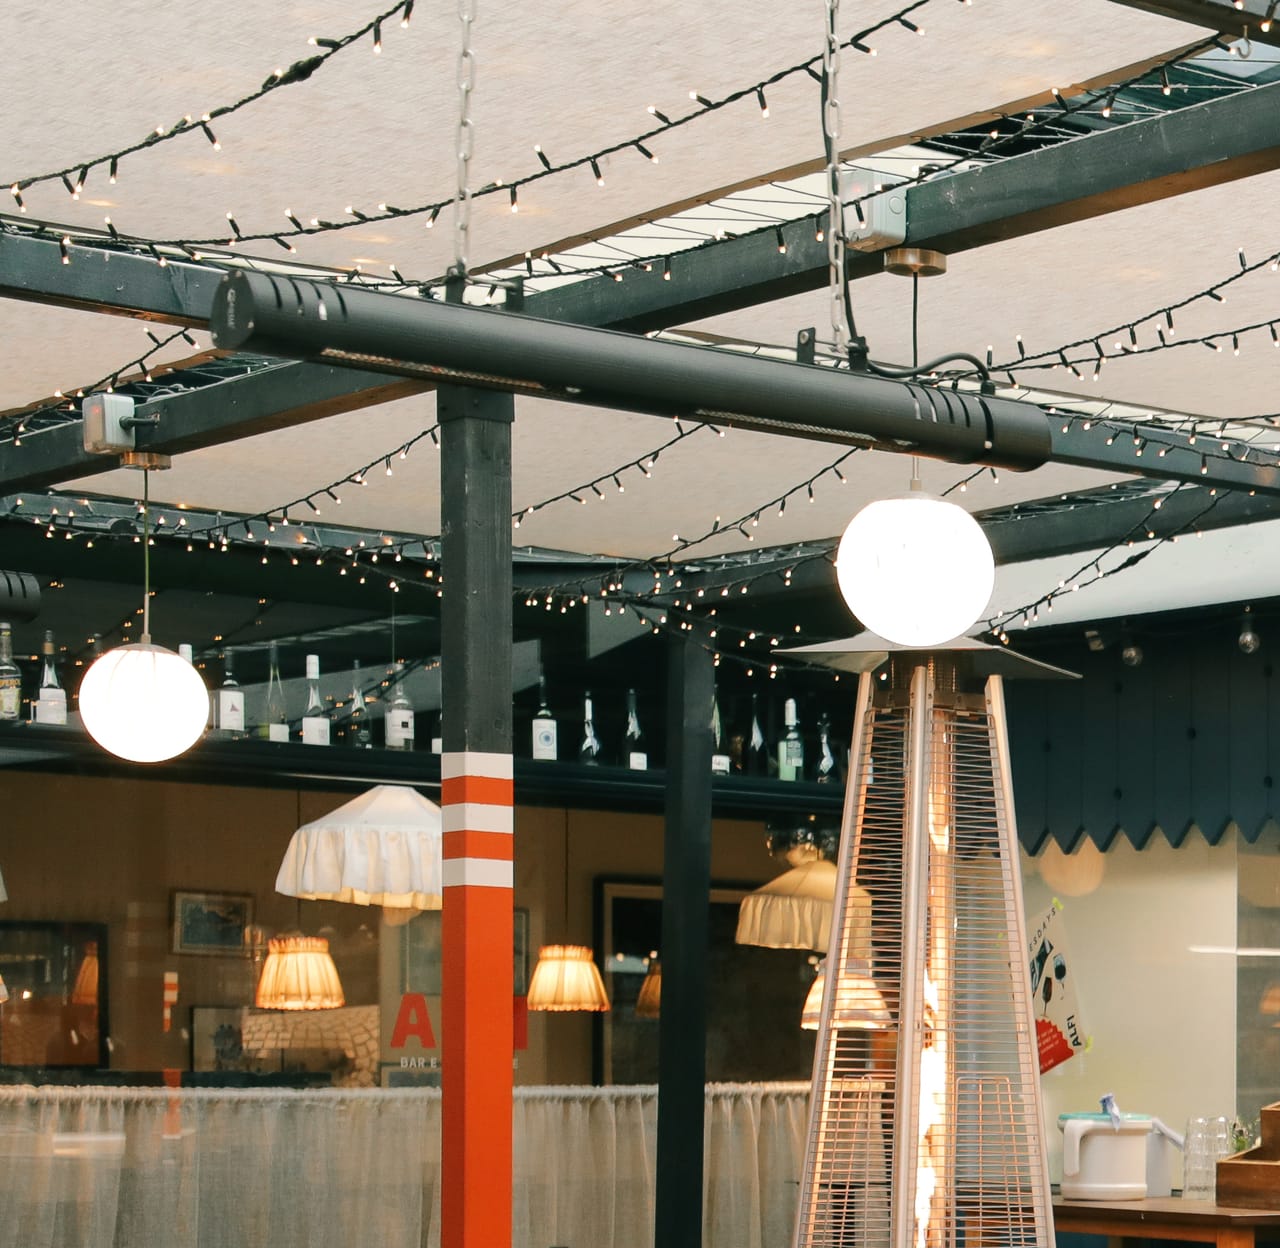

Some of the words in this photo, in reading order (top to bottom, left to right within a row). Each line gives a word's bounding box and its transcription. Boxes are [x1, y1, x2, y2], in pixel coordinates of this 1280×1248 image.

[1029, 907, 1056, 952] ESDAYS
[1066, 1014, 1082, 1047] ALFI
[400, 1057, 425, 1069] BAR
